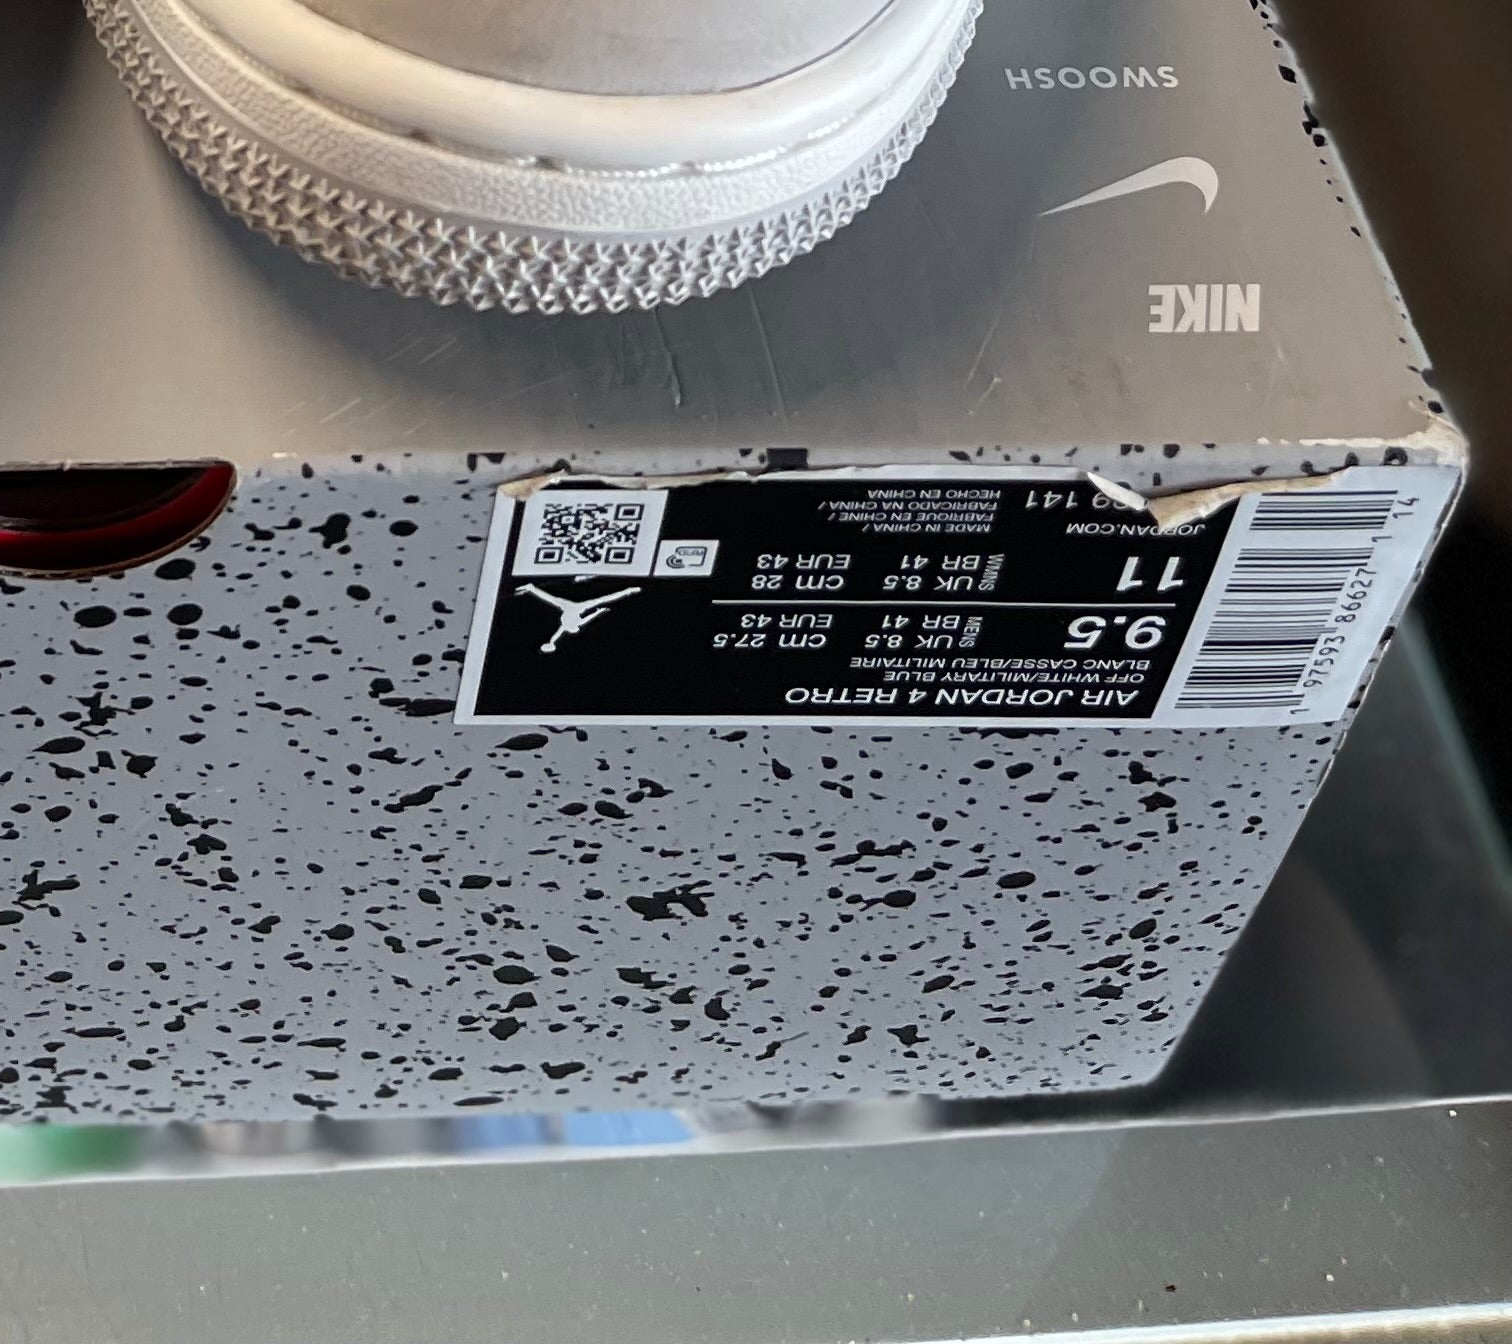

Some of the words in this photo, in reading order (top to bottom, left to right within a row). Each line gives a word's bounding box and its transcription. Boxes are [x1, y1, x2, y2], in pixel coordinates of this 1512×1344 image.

[1004, 65, 1179, 90] SWOOSH
[1148, 283, 1260, 332] NIKE
[867, 489, 916, 498] CHINA
[920, 489, 941, 498] EN
[946, 490, 1001, 499] HECHO
[1025, 490, 1078, 508] 141
[828, 501, 878, 510] CHINA
[882, 501, 904, 510] NA
[908, 501, 998, 510] FABRICADO
[838, 512, 887, 521] CHINE
[891, 512, 912, 521] EN
[916, 512, 994, 521] FABRIQUE
[873, 523, 922, 532] CHINA
[925, 523, 940, 532] IN
[945, 523, 991, 532] MADE
[756, 554, 788, 569] 43
[796, 554, 850, 569] EUR
[900, 555, 928, 570] 41
[942, 555, 980, 570] BR
[978, 553, 1004, 591] WMNS
[1116, 556, 1184, 591] 11
[752, 574, 783, 590] 28
[795, 574, 844, 590] cm
[882, 576, 922, 590] 8.5
[934, 576, 974, 590] UK
[740, 614, 772, 628] 43
[779, 614, 833, 628] EUR
[882, 614, 909, 628] 41
[922, 615, 960, 629] BR
[1302, 634, 1345, 688] 97593
[1334, 568, 1376, 624] 86627
[958, 616, 984, 648] MENS
[1064, 616, 1166, 650] 9.5
[712, 634, 766, 648] 27.5
[778, 634, 826, 648] cm
[864, 634, 903, 648] 8.5
[914, 634, 953, 648] UK
[850, 656, 946, 668] MILITAIRE
[952, 658, 1077, 670] CASSE/BLEU
[1082, 659, 1150, 670] BLANC
[883, 670, 936, 681] BLUE
[940, 671, 1100, 682] WHITE/MILITARY
[1104, 672, 1144, 683] OFF
[784, 687, 898, 704] RETRO
[908, 688, 926, 704] 4
[934, 688, 1073, 705] JORDAN
[1080, 690, 1139, 706] AIR
